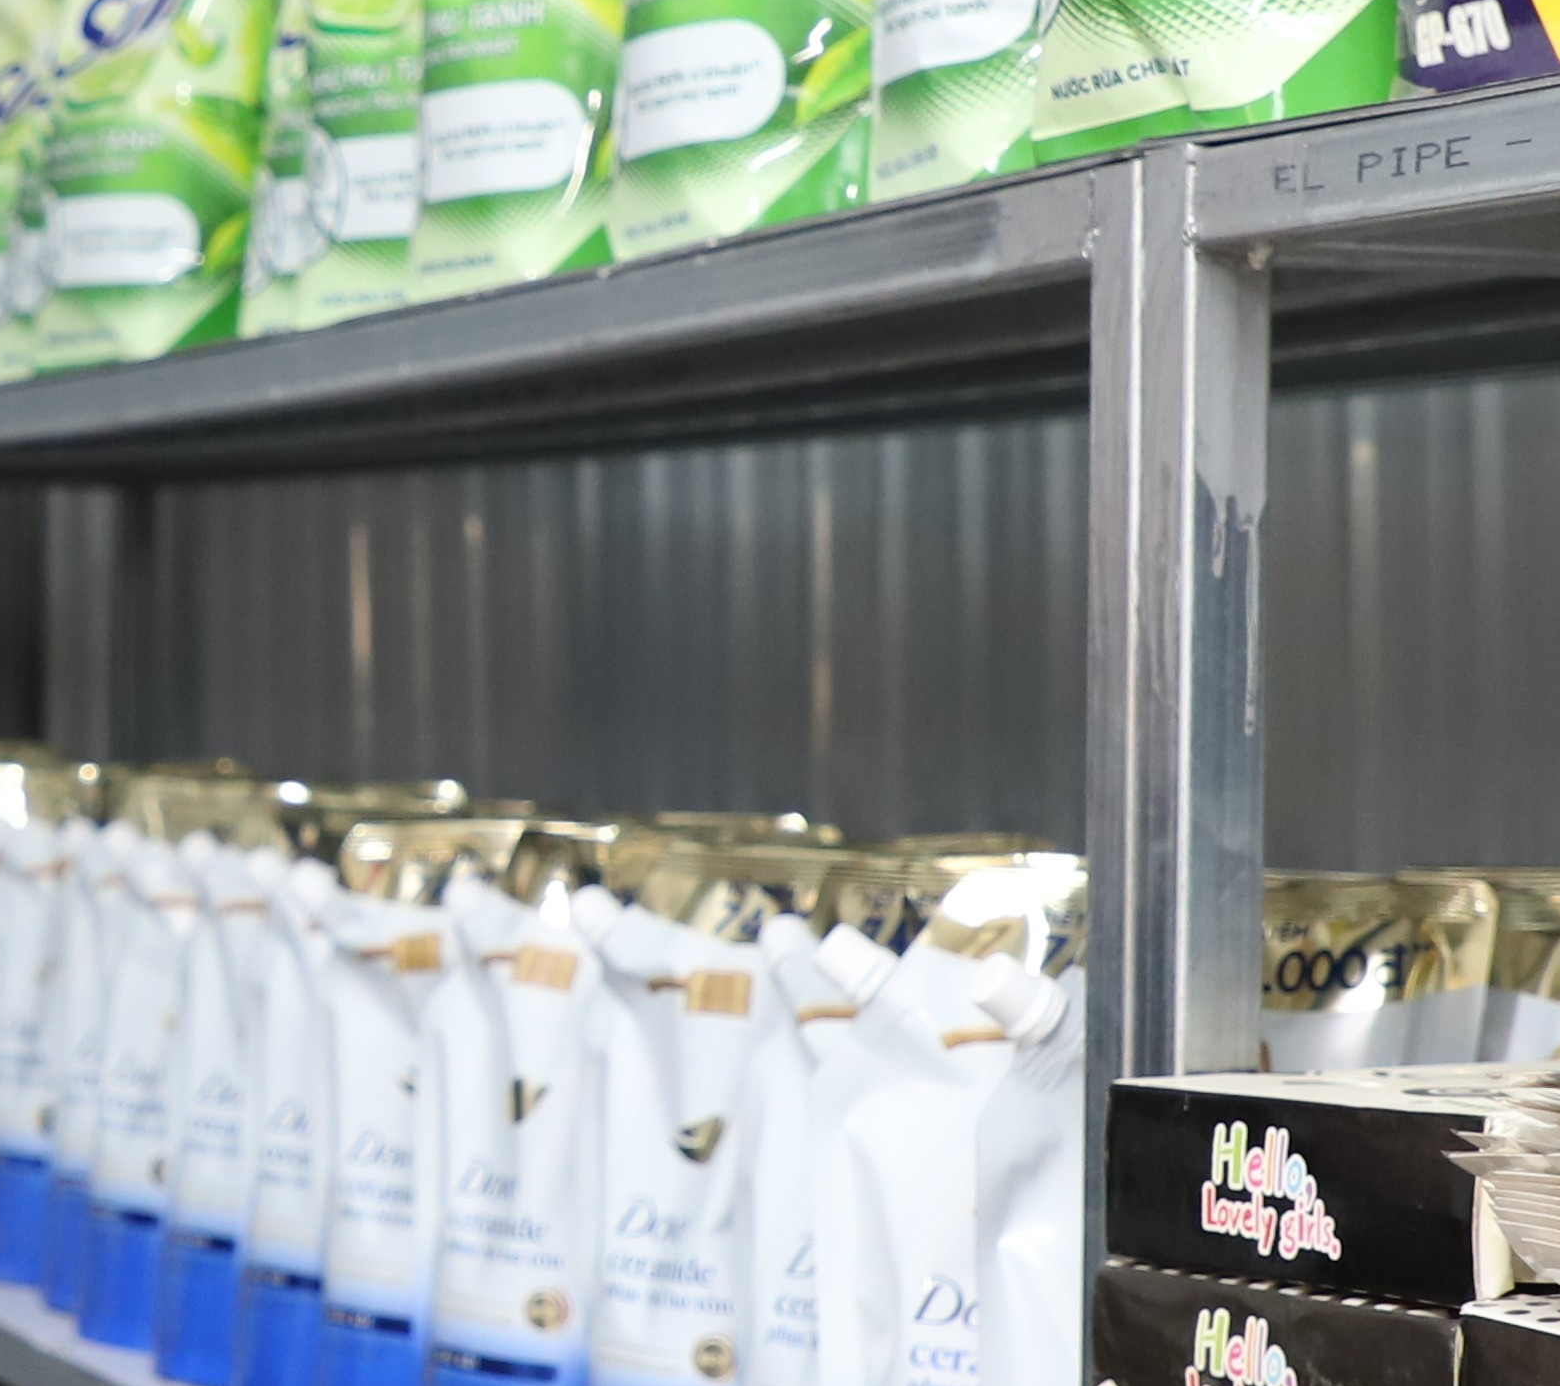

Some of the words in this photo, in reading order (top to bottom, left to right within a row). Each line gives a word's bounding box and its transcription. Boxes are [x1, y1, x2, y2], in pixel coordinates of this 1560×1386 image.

[1358, 135, 1472, 185] PIPE
[1211, 1120, 1316, 1205] Hello,
[1201, 1185, 1274, 1257] Lovely
[1279, 1196, 1342, 1261] girls.
